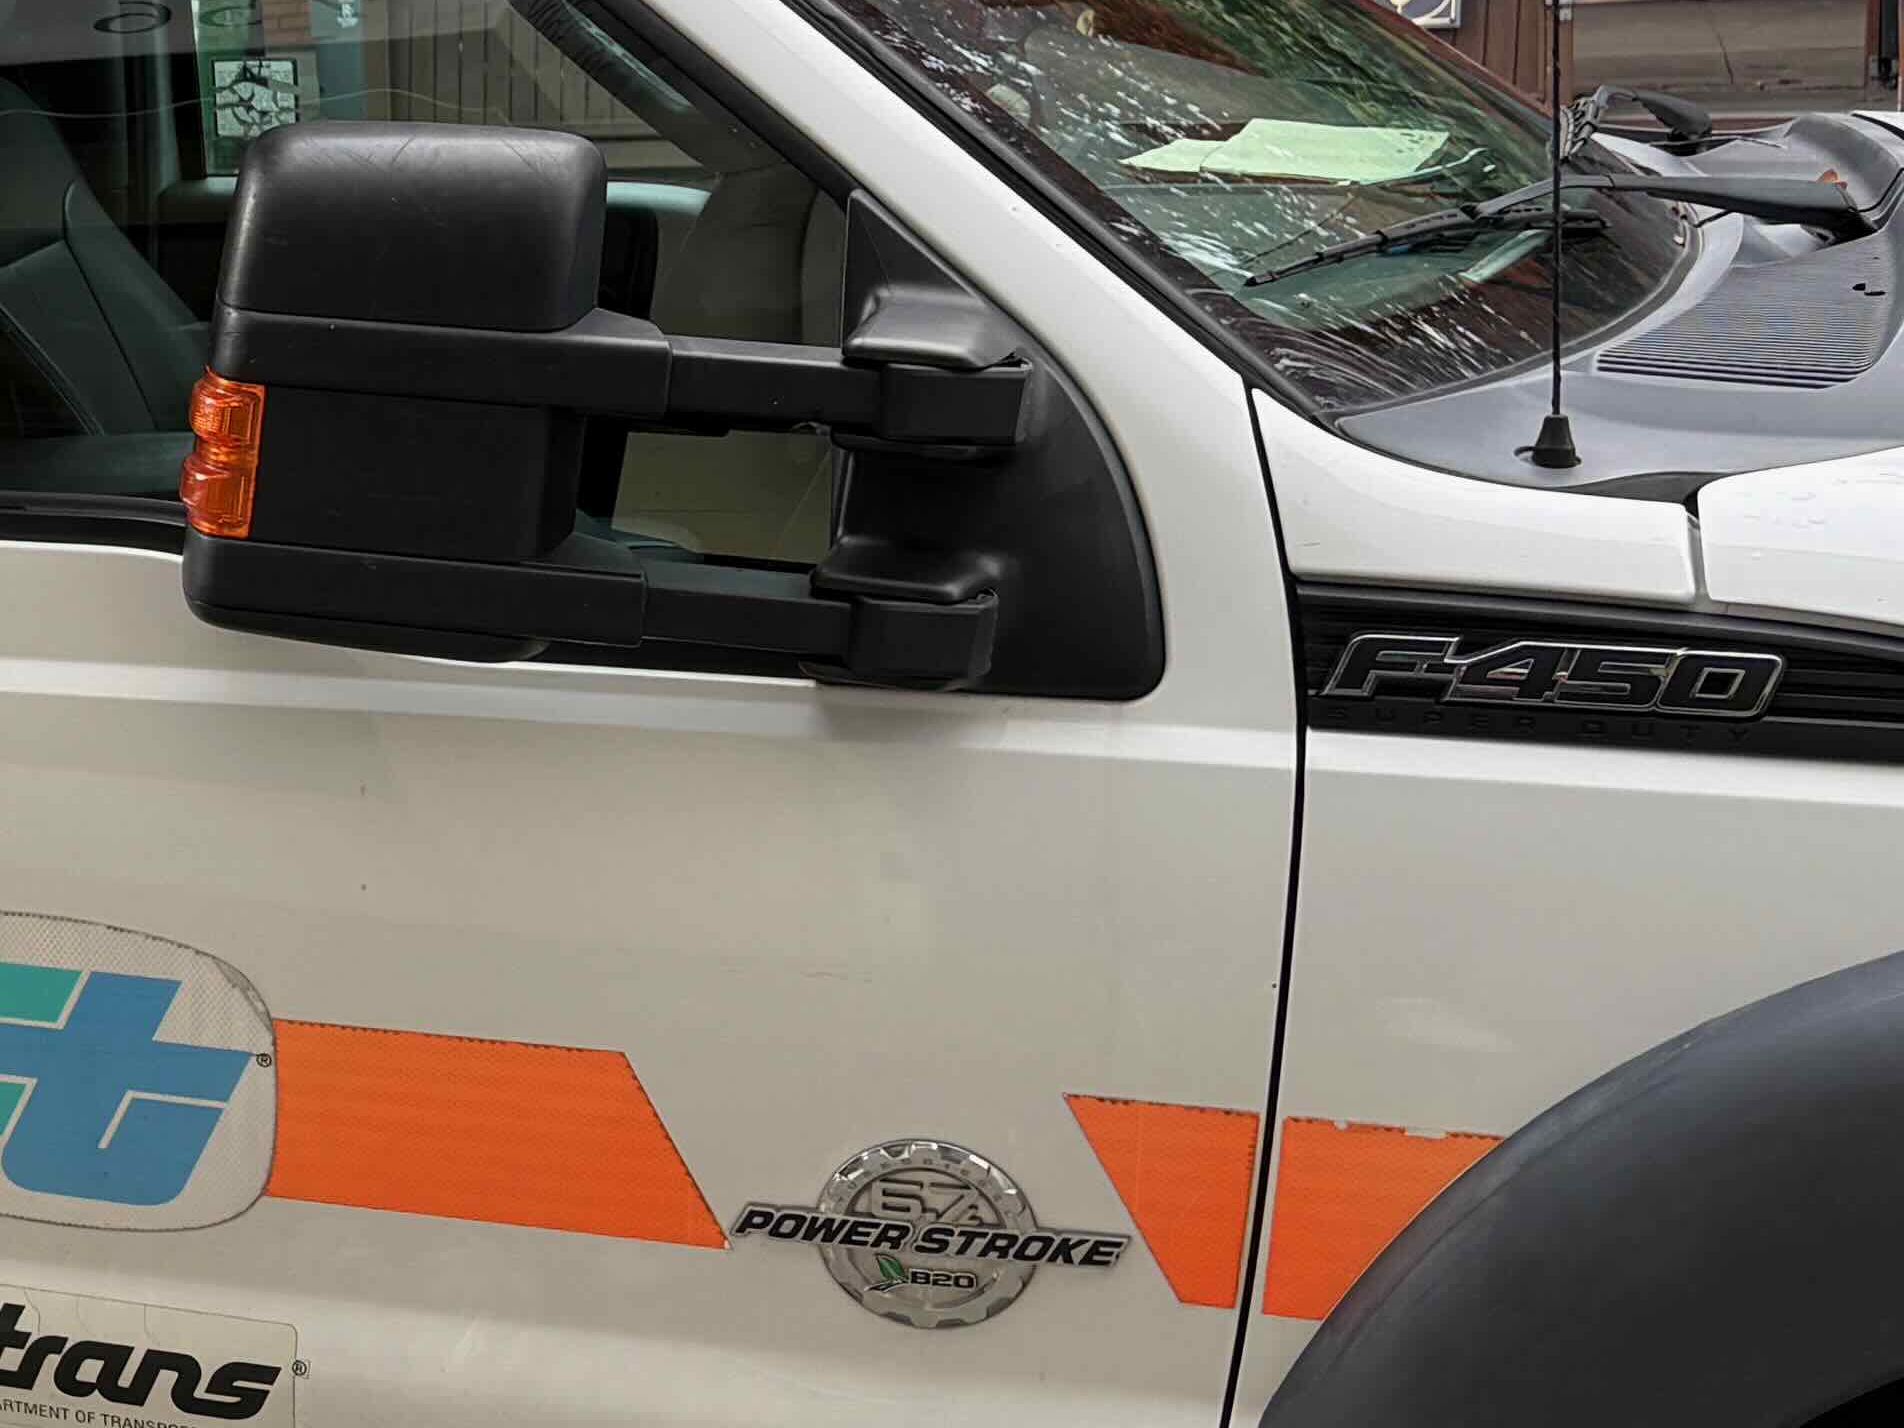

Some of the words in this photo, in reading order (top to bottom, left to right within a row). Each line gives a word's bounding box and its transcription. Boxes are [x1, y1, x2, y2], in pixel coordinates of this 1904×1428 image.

[1320, 632, 1786, 719] F-450
[1326, 706, 1538, 734] SUPER
[1579, 720, 1752, 743] DUTY
[735, 1207, 912, 1250] POWER
[914, 1226, 1128, 1267] STROKE
[910, 1269, 978, 1291] B20
[74, 1409, 96, 1423] OF
